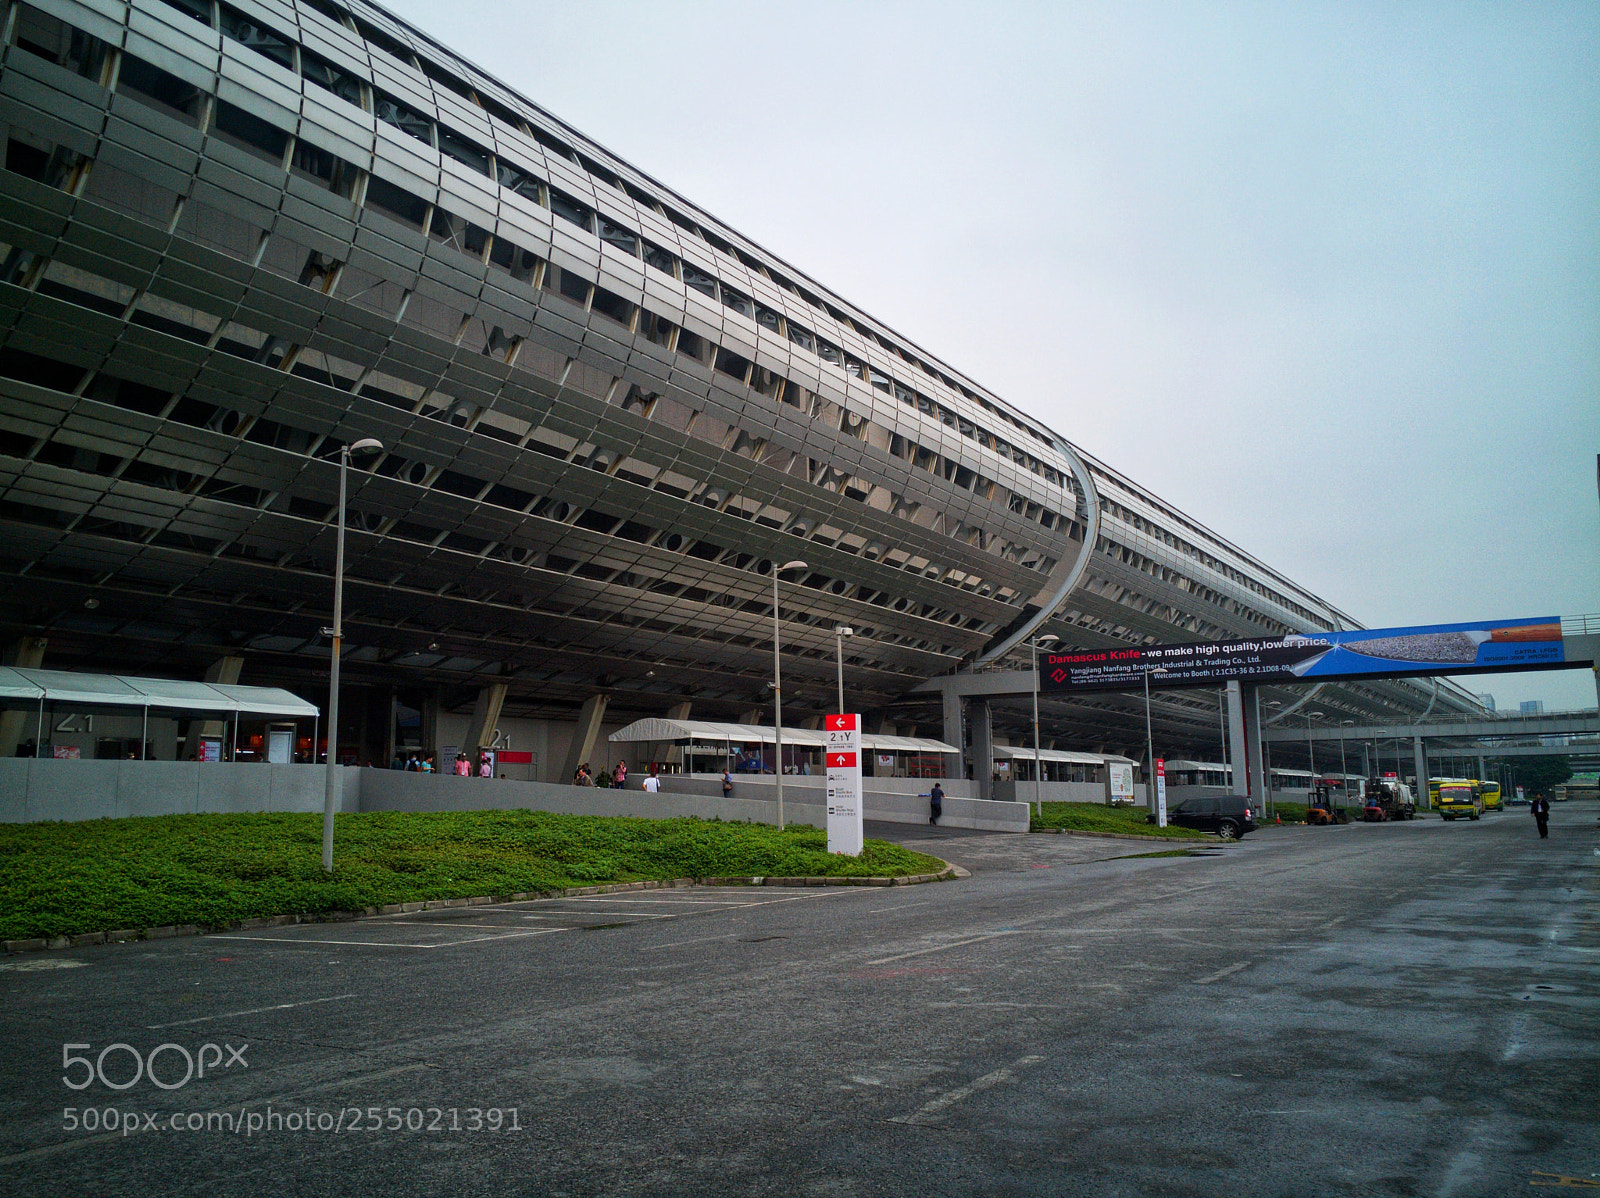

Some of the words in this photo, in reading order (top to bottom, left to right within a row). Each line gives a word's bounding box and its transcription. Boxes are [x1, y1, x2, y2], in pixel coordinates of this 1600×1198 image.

[1048, 653, 1107, 664] Damascus
[1164, 647, 1194, 656] make
[1195, 644, 1220, 655] high
[1297, 637, 1331, 649] price.
[1070, 666, 1102, 675] Yangjiang
[1103, 664, 1131, 672] Nanfang
[1132, 662, 1161, 671] Brothers
[1162, 659, 1194, 668] Industrial
[1195, 659, 1202, 667] &
[1203, 658, 1231, 666] Trading
[1153, 671, 1182, 679] Welcome
